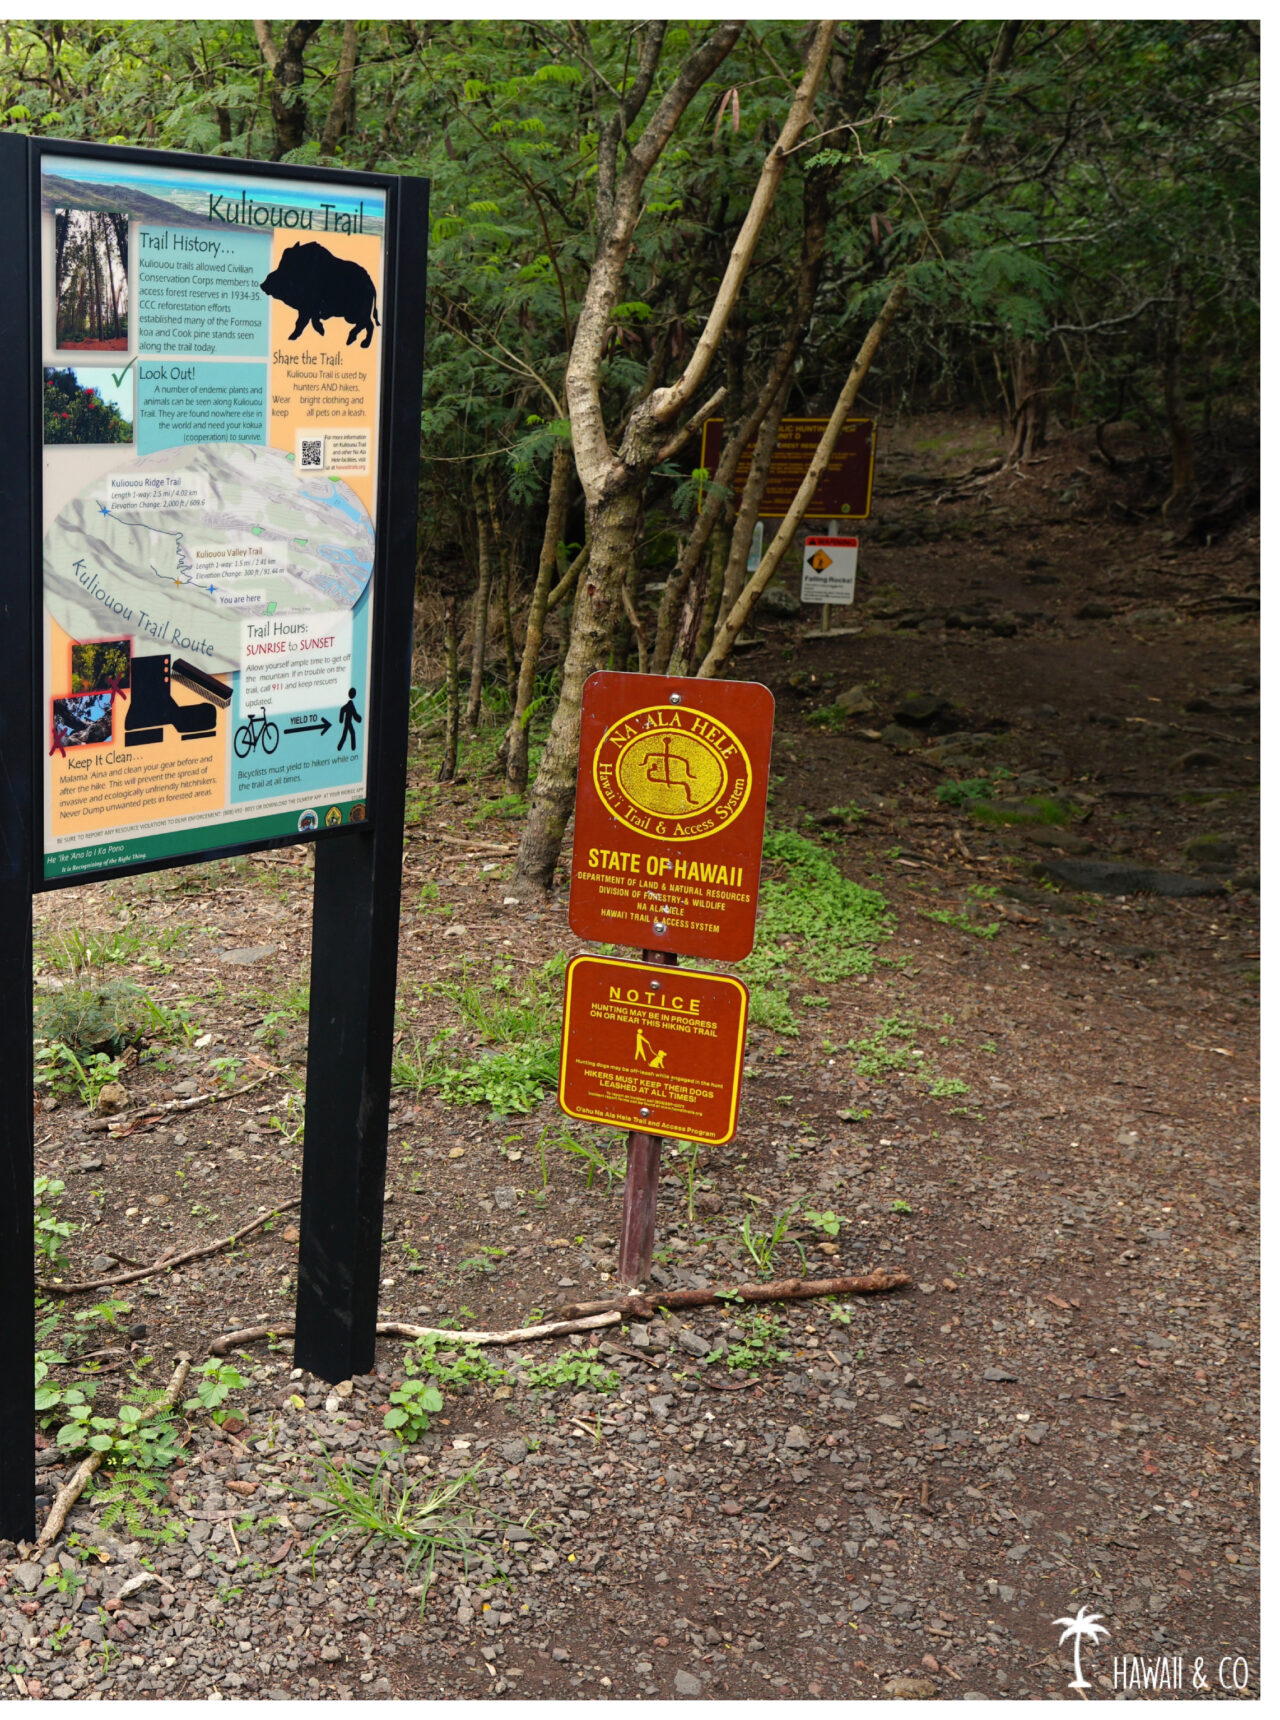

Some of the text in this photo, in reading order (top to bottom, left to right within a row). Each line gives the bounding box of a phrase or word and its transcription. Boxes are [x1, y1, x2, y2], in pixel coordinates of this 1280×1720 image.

[209, 190, 363, 235] Kuliouou Trail
[140, 231, 168, 250] Trail
[273, 349, 343, 366] Share the Trail:
[140, 366, 195, 380] Look Out!
[111, 479, 143, 487] Kuliouou
[145, 478, 164, 488] Ridge
[72, 558, 214, 656] Kuliouou Trail Route
[220, 596, 232, 604] You
[247, 622, 308, 638] Trail Hours:
[246, 637, 335, 657] SUNRISE to SUNSET
[290, 714, 318, 725] YIELD TO
[609, 724, 637, 749] NA
[691, 718, 738, 759] HELE
[68, 758, 92, 771] Keep
[95, 755, 103, 766] It
[624, 805, 651, 829] Trail
[656, 821, 666, 834] &
[673, 819, 714, 836] Access
[715, 778, 744, 819] System
[589, 848, 742, 887] STATE OF HAWAII
[577, 872, 625, 885] DEPARTMENT
[627, 878, 636, 886] OF
[639, 880, 658, 889] LAND
[669, 884, 703, 896] NATURAL
[706, 890, 750, 902] RESOURCES
[599, 886, 629, 896] DIVISION
[632, 890, 641, 898] OF
[644, 891, 681, 903] FORESTRY
[692, 899, 725, 911] WILDLIFE
[610, 986, 700, 1012] NOTICE
[591, 1003, 627, 1014] HUNTING
[630, 1009, 647, 1017] MAY
[671, 1016, 717, 1029] PROGRESS
[617, 1015, 639, 1024] NEAR
[642, 1019, 660, 1027] THIS
[662, 1022, 690, 1033] HIKING
[693, 1027, 717, 1037] TRAIL
[585, 1069, 714, 1098] HIKERS MUST KEEP THEIR DOGS
[600, 1080, 637, 1092] LEASHED
[651, 1089, 666, 1097] ALL
[669, 1091, 696, 1102] TIMES!
[633, 1116, 647, 1125] Trail
[662, 1122, 685, 1132] Access
[687, 1127, 715, 1137] Program
